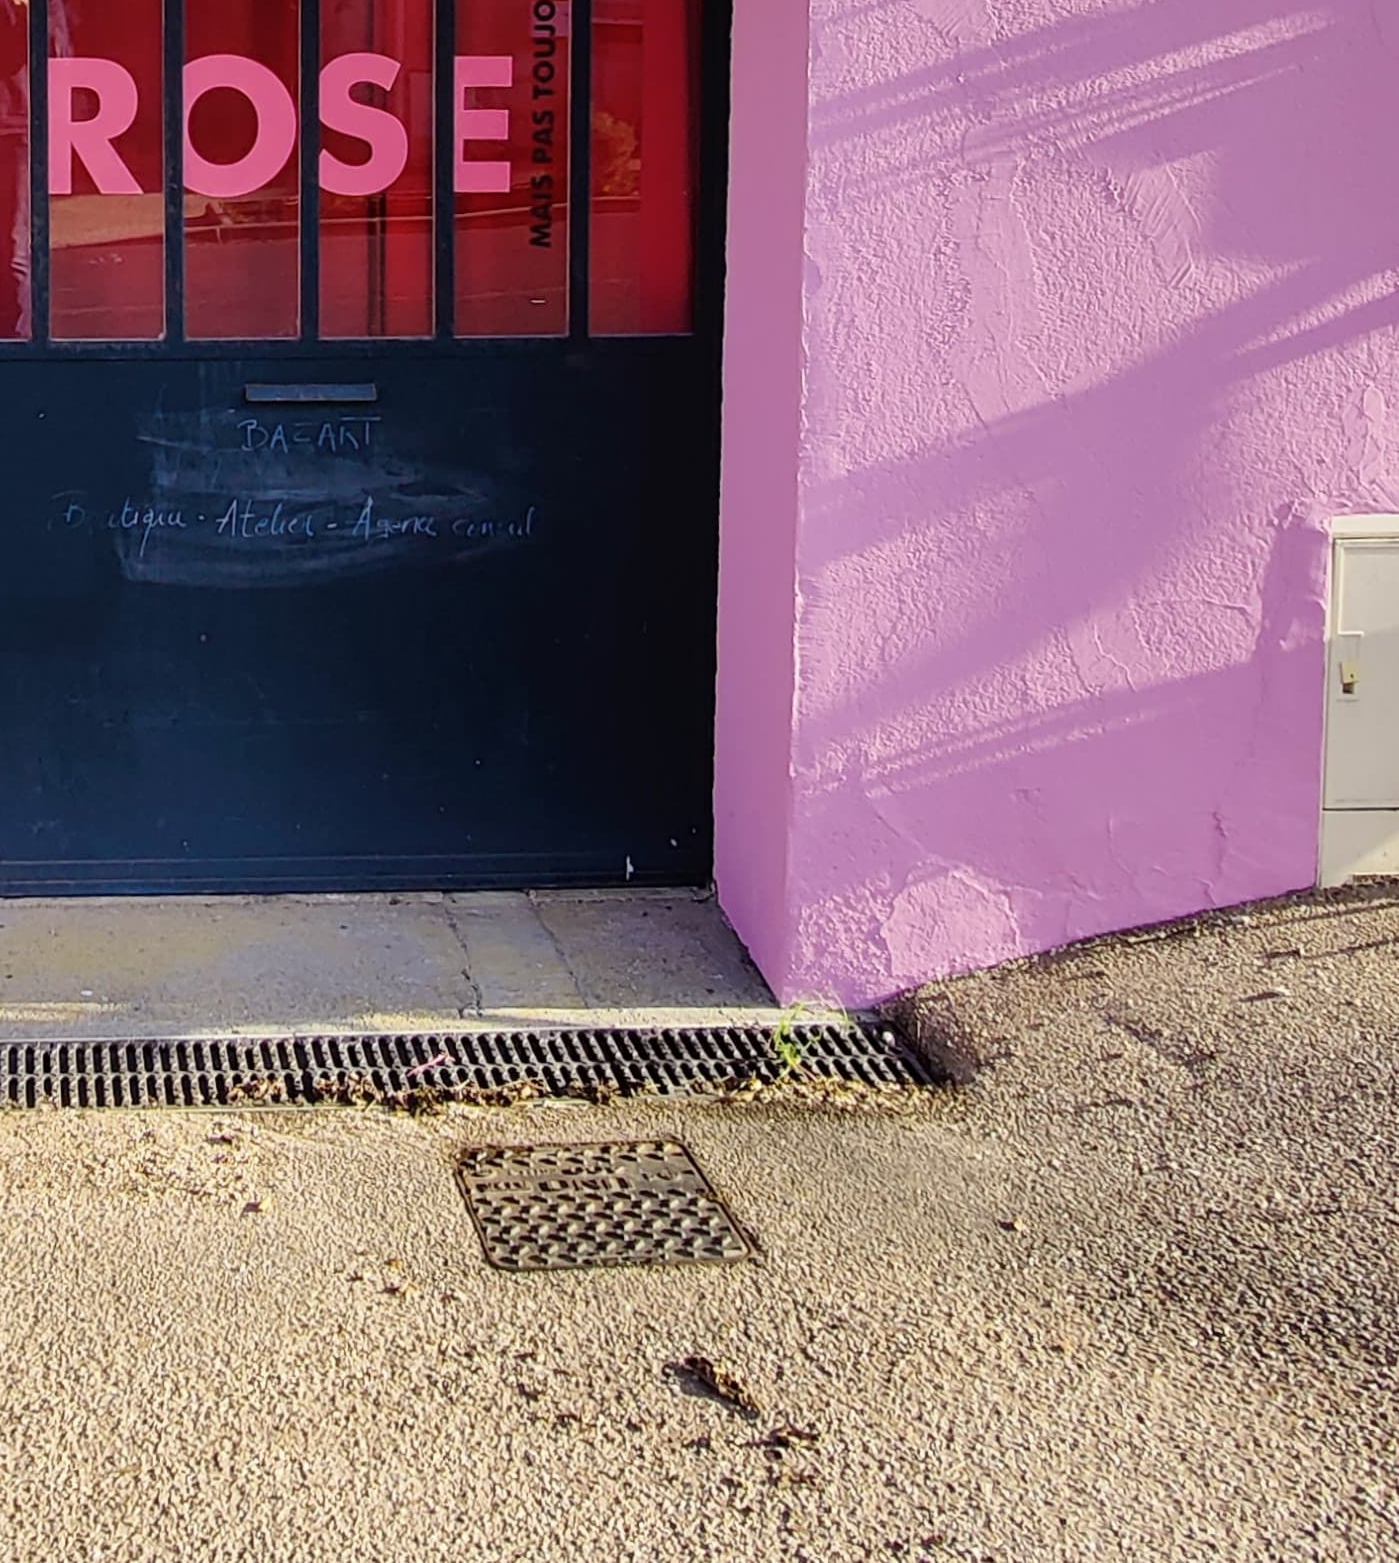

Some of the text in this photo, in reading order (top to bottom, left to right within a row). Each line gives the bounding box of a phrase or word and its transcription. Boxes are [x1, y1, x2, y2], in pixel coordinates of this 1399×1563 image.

[47, 51, 514, 199] ROSE
[531, 109, 555, 164] PAS
[529, 173, 553, 249] MAIS
